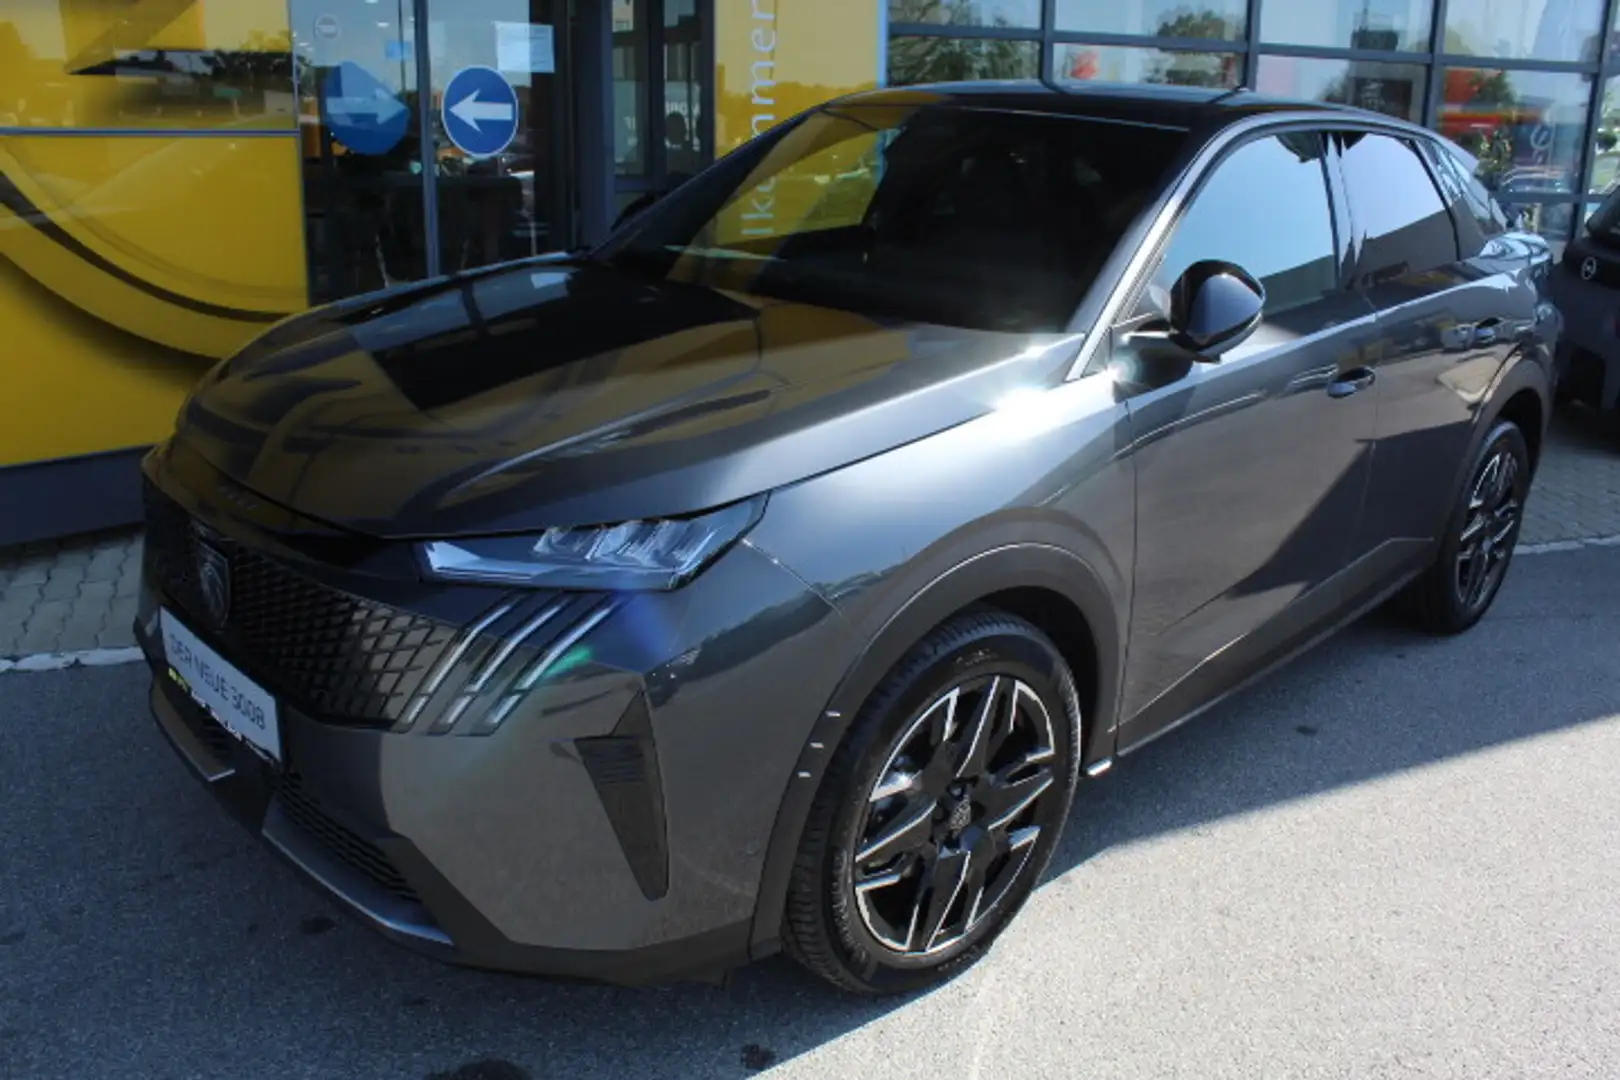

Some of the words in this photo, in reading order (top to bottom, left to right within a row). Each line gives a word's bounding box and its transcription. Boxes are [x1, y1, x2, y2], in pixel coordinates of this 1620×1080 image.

[170, 634, 193, 668] DER
[194, 654, 229, 701] NEUE
[230, 686, 266, 730] 3008
